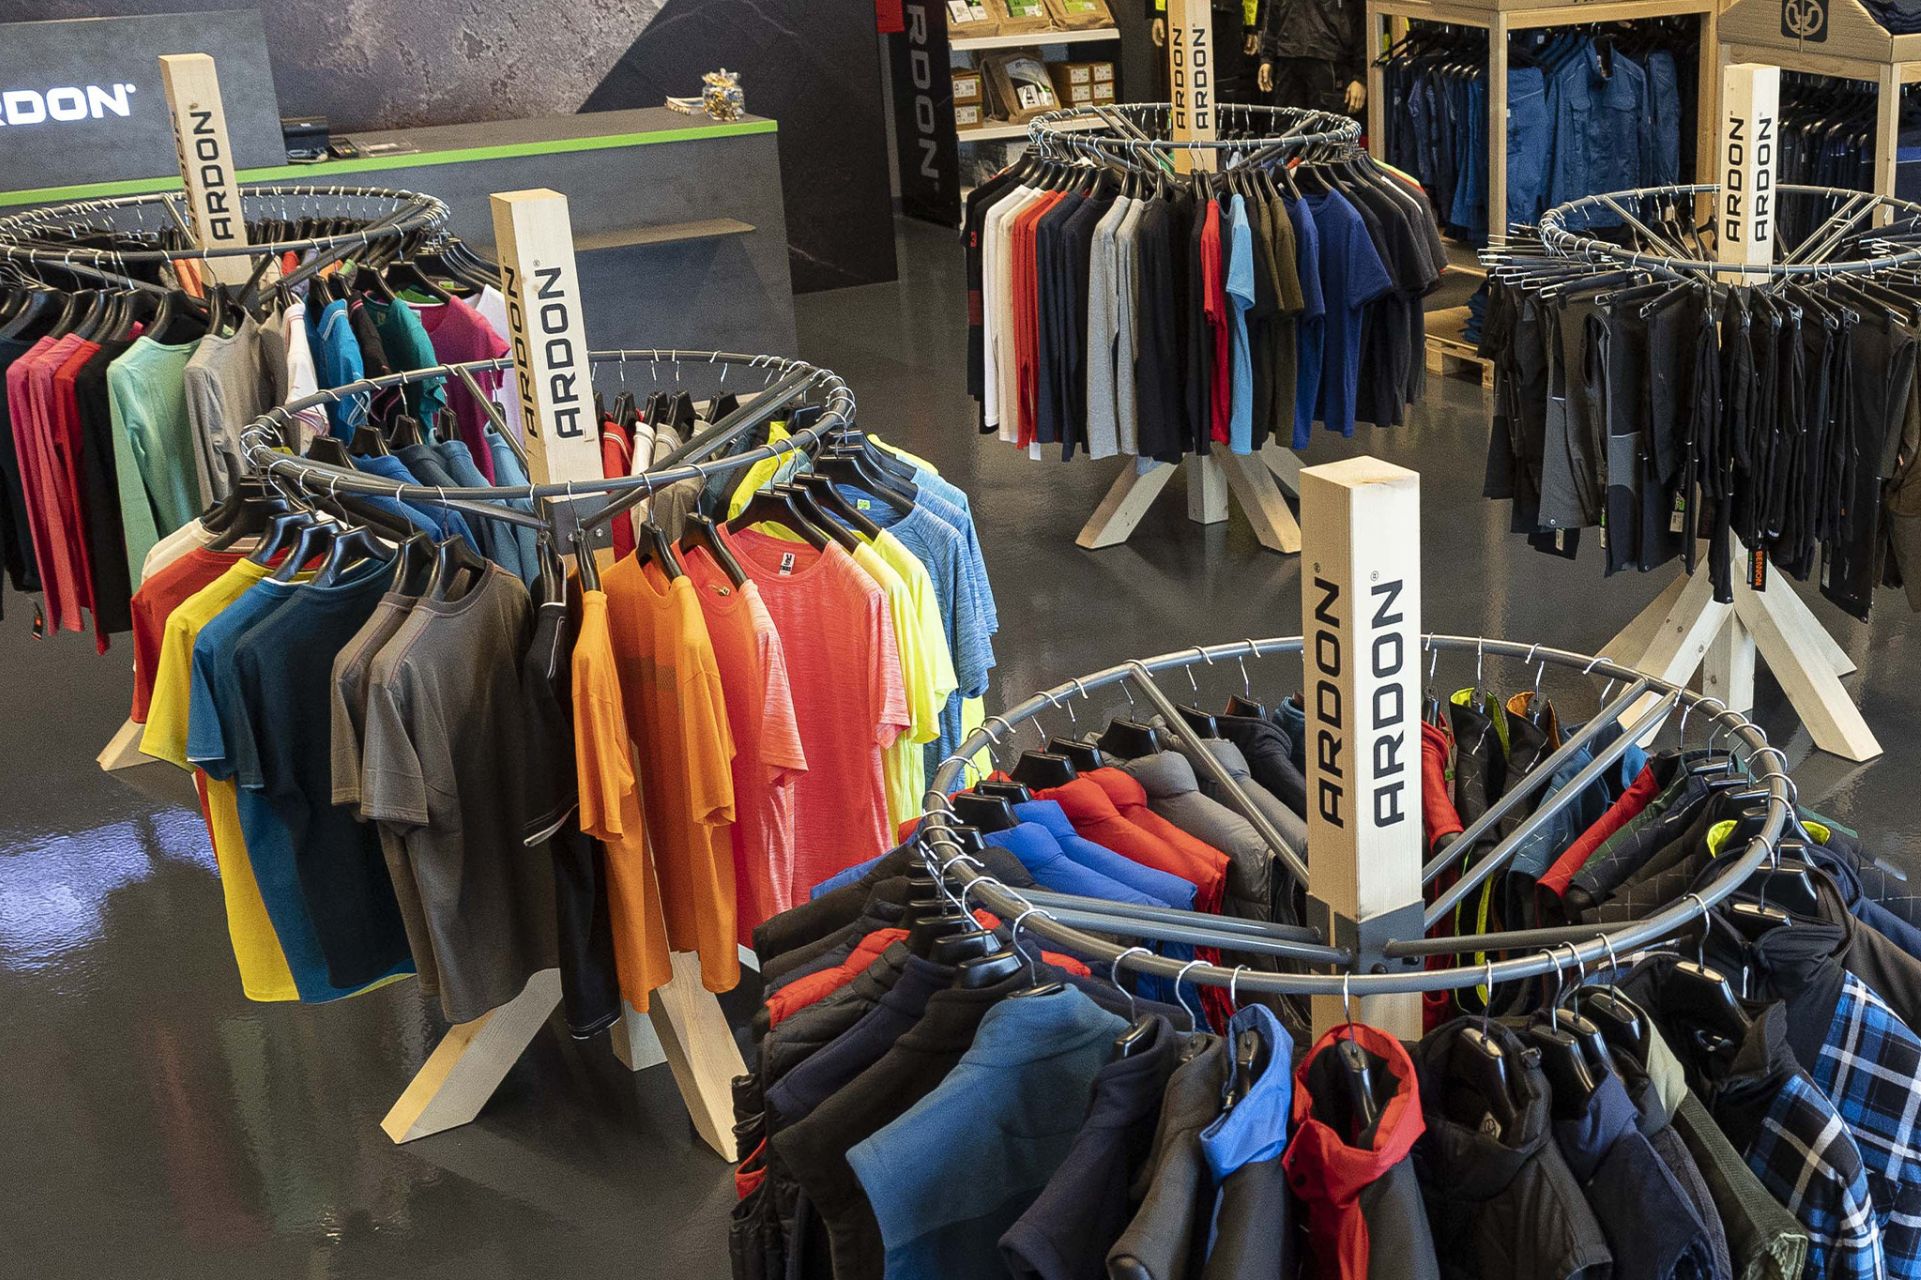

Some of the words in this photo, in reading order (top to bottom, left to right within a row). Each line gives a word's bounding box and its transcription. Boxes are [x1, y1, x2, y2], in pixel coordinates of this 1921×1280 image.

[0, 83, 131, 126] DON
[1173, 28, 1186, 129] ARDON
[1192, 28, 1209, 129] ARDON
[190, 110, 235, 241] ARDON
[1726, 117, 1745, 243] ARDON
[1755, 117, 1772, 242] ARDON
[504, 266, 538, 438] ARDON
[534, 266, 584, 439] ARDON
